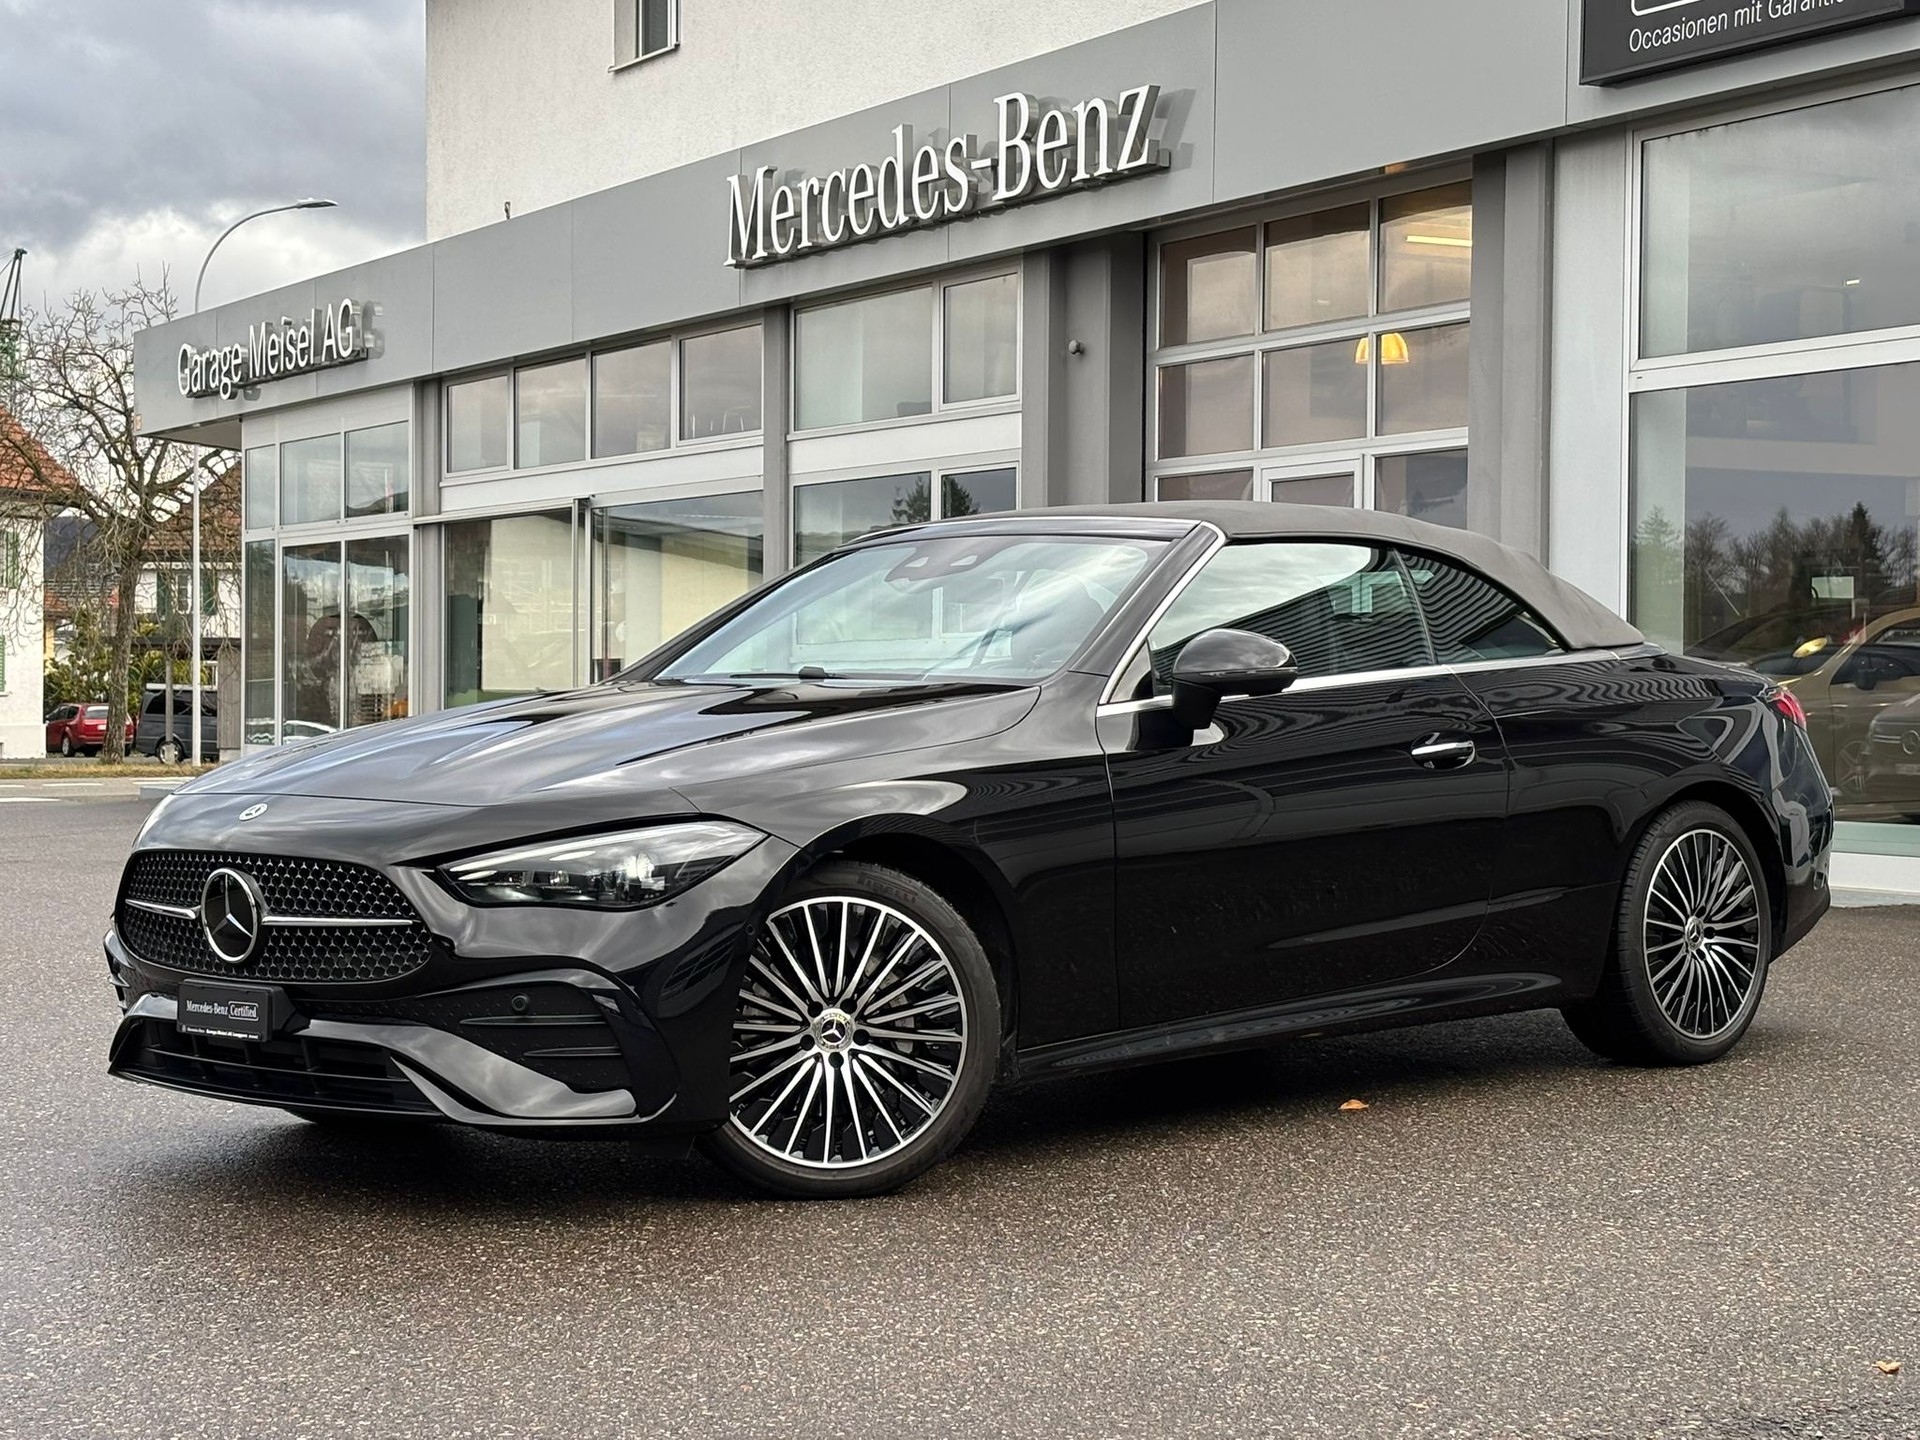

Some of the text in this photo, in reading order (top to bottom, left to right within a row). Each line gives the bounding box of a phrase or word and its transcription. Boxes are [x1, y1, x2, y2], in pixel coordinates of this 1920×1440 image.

[1629, 0, 1844, 52] Occasionen mit Gara
[724, 84, 1157, 267] Mercedes-Benz
[178, 298, 353, 400] Garage Meisel AG
[186, 1000, 257, 1018] Mercedes-Benz Certified
